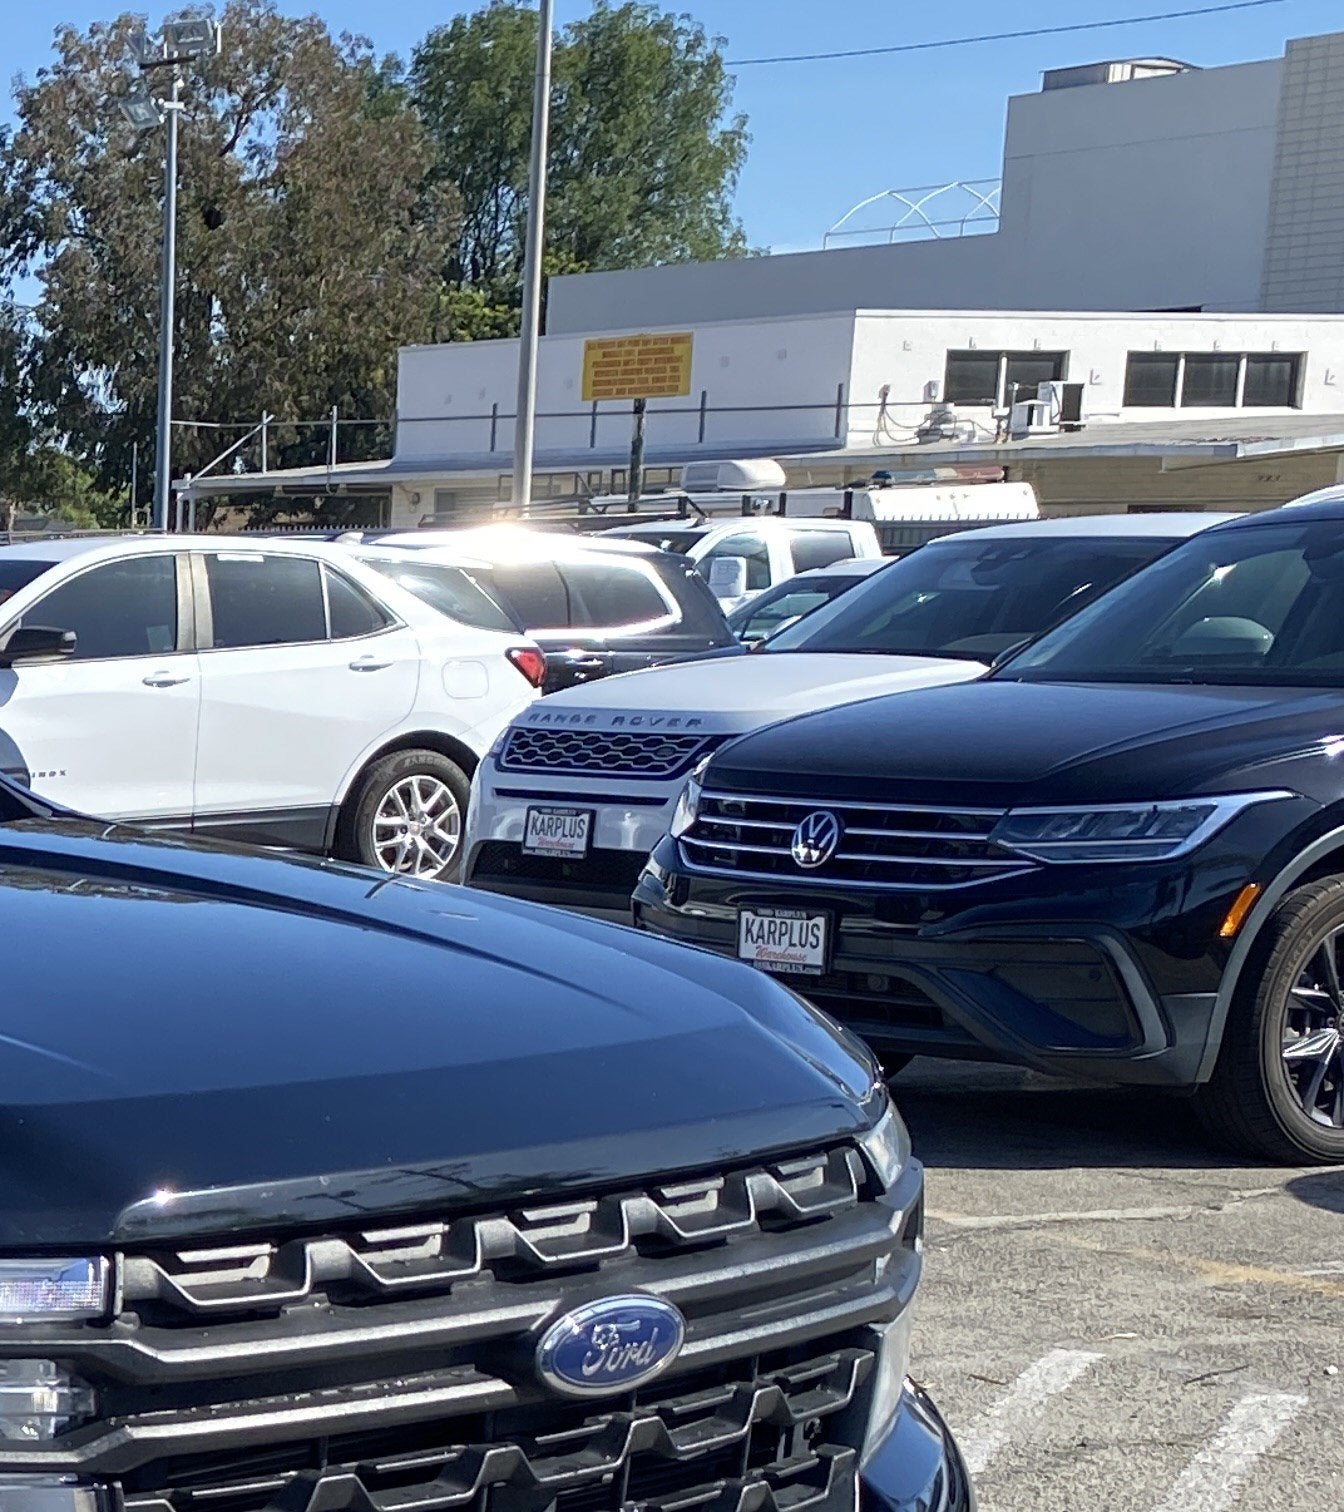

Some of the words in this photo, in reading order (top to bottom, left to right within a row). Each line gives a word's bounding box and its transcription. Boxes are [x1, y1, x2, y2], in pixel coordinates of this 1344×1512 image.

[527, 712, 598, 724] RANGE
[611, 715, 703, 729] ROVER
[529, 814, 586, 840] KARPLUS
[744, 917, 821, 950] KARPLUS
[581, 1319, 660, 1377] Ford
